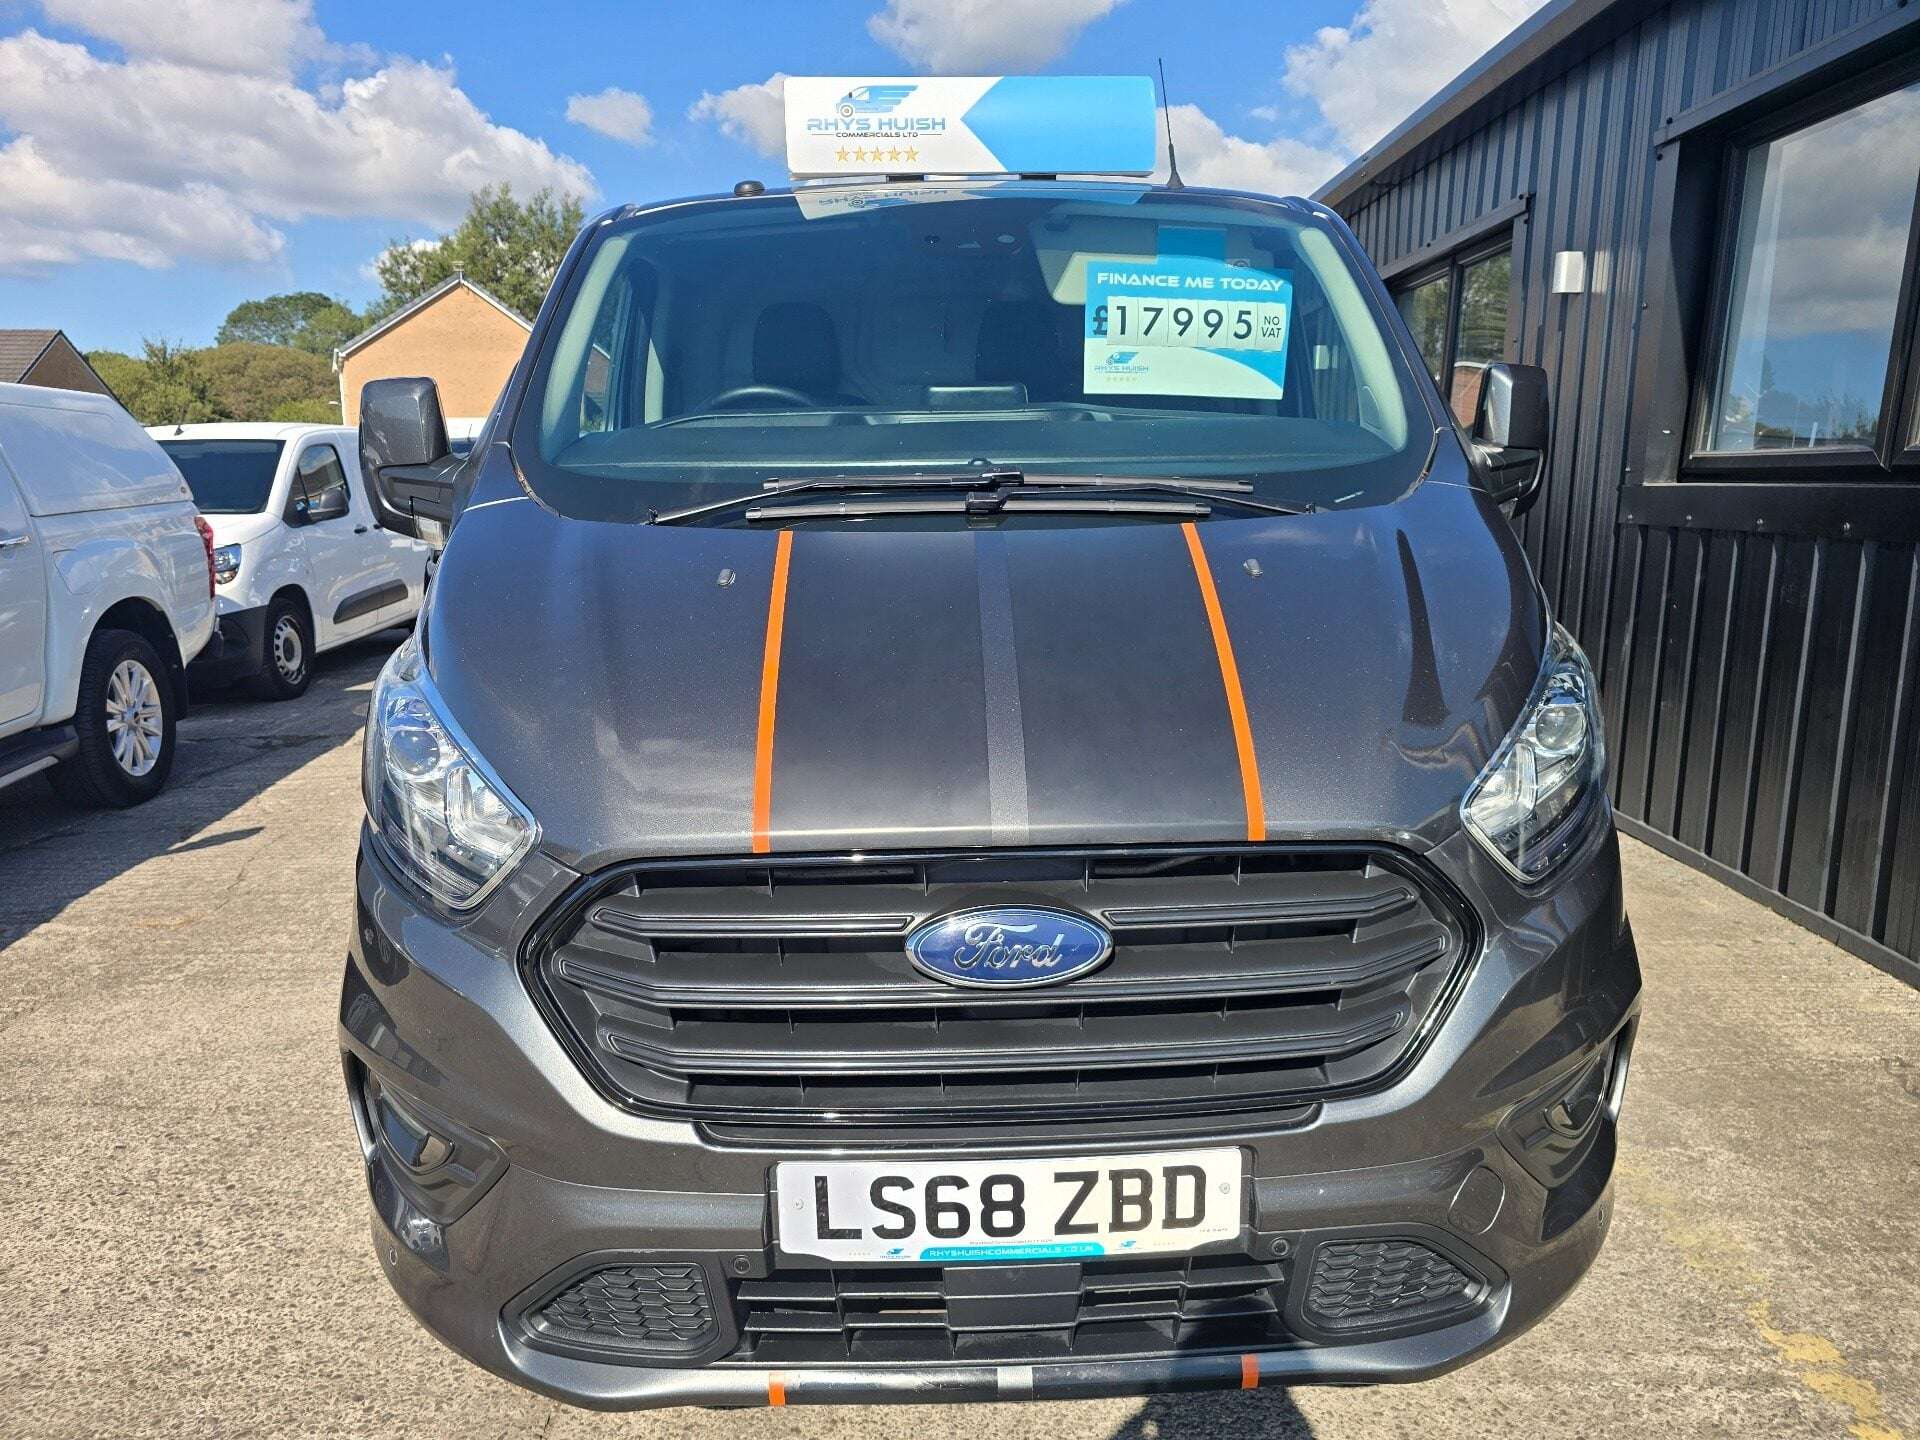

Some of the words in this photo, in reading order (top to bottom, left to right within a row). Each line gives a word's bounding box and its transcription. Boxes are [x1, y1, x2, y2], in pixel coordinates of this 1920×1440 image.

[807, 118, 871, 131] RHYS
[878, 118, 946, 131] HUISH
[1097, 272, 1180, 288] FINANCE
[1184, 276, 1215, 289] ME
[1219, 277, 1284, 292] TODAY
[1263, 315, 1281, 325] NO
[1261, 327, 1282, 339] VAT
[953, 922, 1065, 970] Ford
[813, 1173, 1026, 1241] LS68
[1053, 1164, 1207, 1236] ZBD
